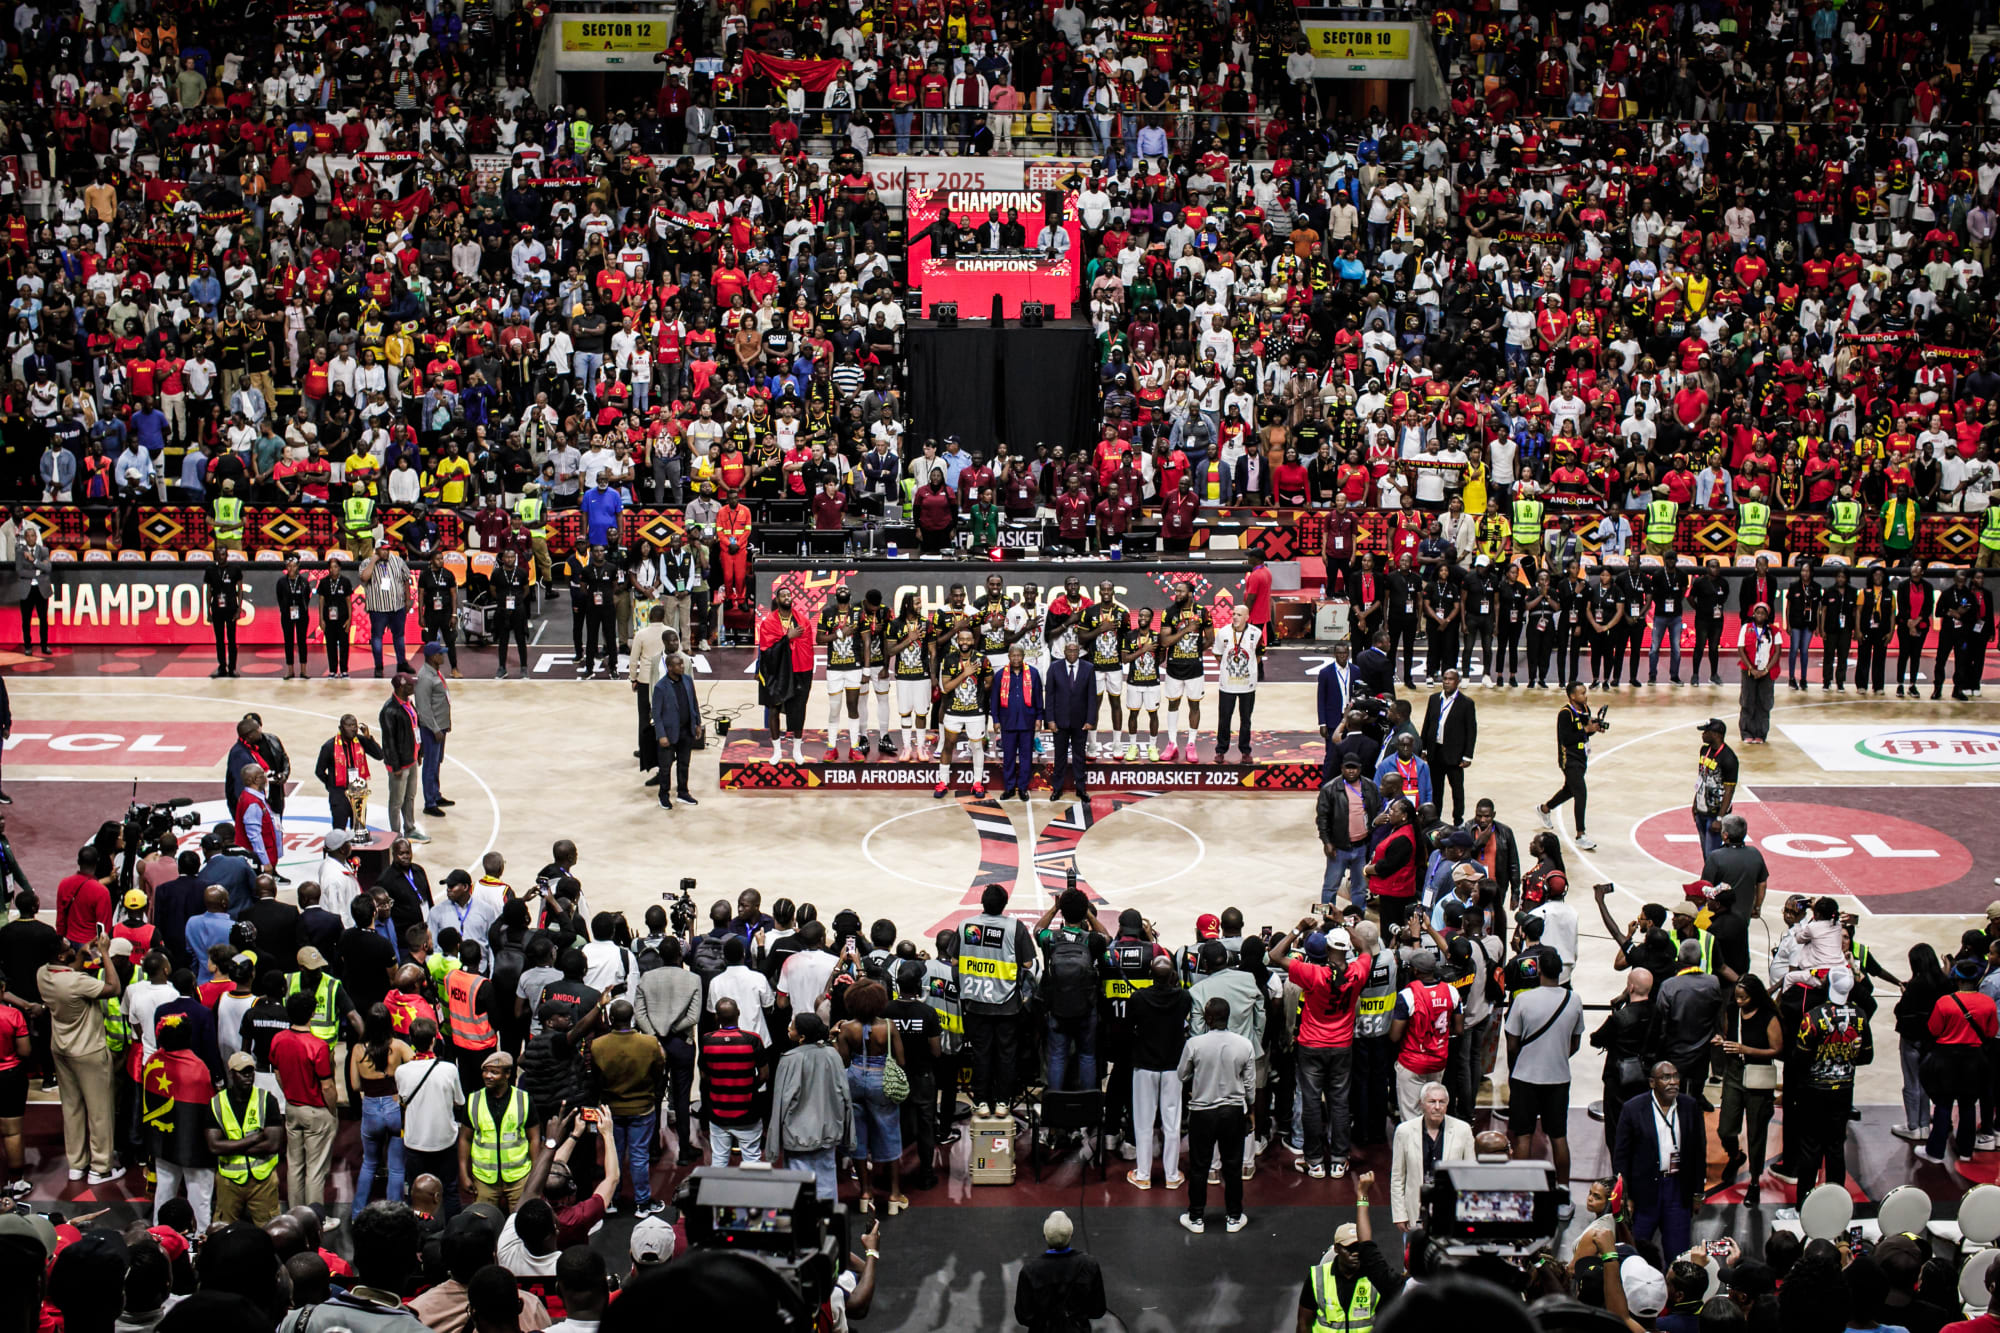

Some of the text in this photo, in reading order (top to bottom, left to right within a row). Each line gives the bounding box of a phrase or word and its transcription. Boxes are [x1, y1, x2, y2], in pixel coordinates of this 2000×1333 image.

[582, 23, 651, 37] SECTOR 12
[1131, 34, 1164, 43] ANGOLA
[1323, 31, 1391, 45] SECTOR 10
[374, 153, 412, 161] ANGOLA
[543, 179, 581, 188] ANGOLA
[937, 172, 984, 190] 2025
[948, 191, 1043, 213] CHAMPIONS
[672, 215, 710, 230] ANGOLA
[955, 260, 1038, 272] CHAMPIONS
[1859, 334, 1899, 343] ANGOLA
[1550, 496, 1594, 505] ANGOLA
[46, 583, 256, 626] HAMPIOS
[824, 769, 857, 784] FIBA
[956, 770, 991, 784] 205
[1109, 771, 1202, 785] AFROBASKET
[1205, 771, 1239, 785] 2025
[986, 928, 1002, 939] FIBA
[1124, 949, 1140, 958] FIBA
[966, 960, 996, 974] PHOTO
[964, 976, 994, 998] 272
[552, 993, 581, 1004] ANGOLA
[1112, 1000, 1127, 1018] 11
[1360, 1001, 1384, 1011] HOTO
[1435, 1010, 1448, 1034] 4
